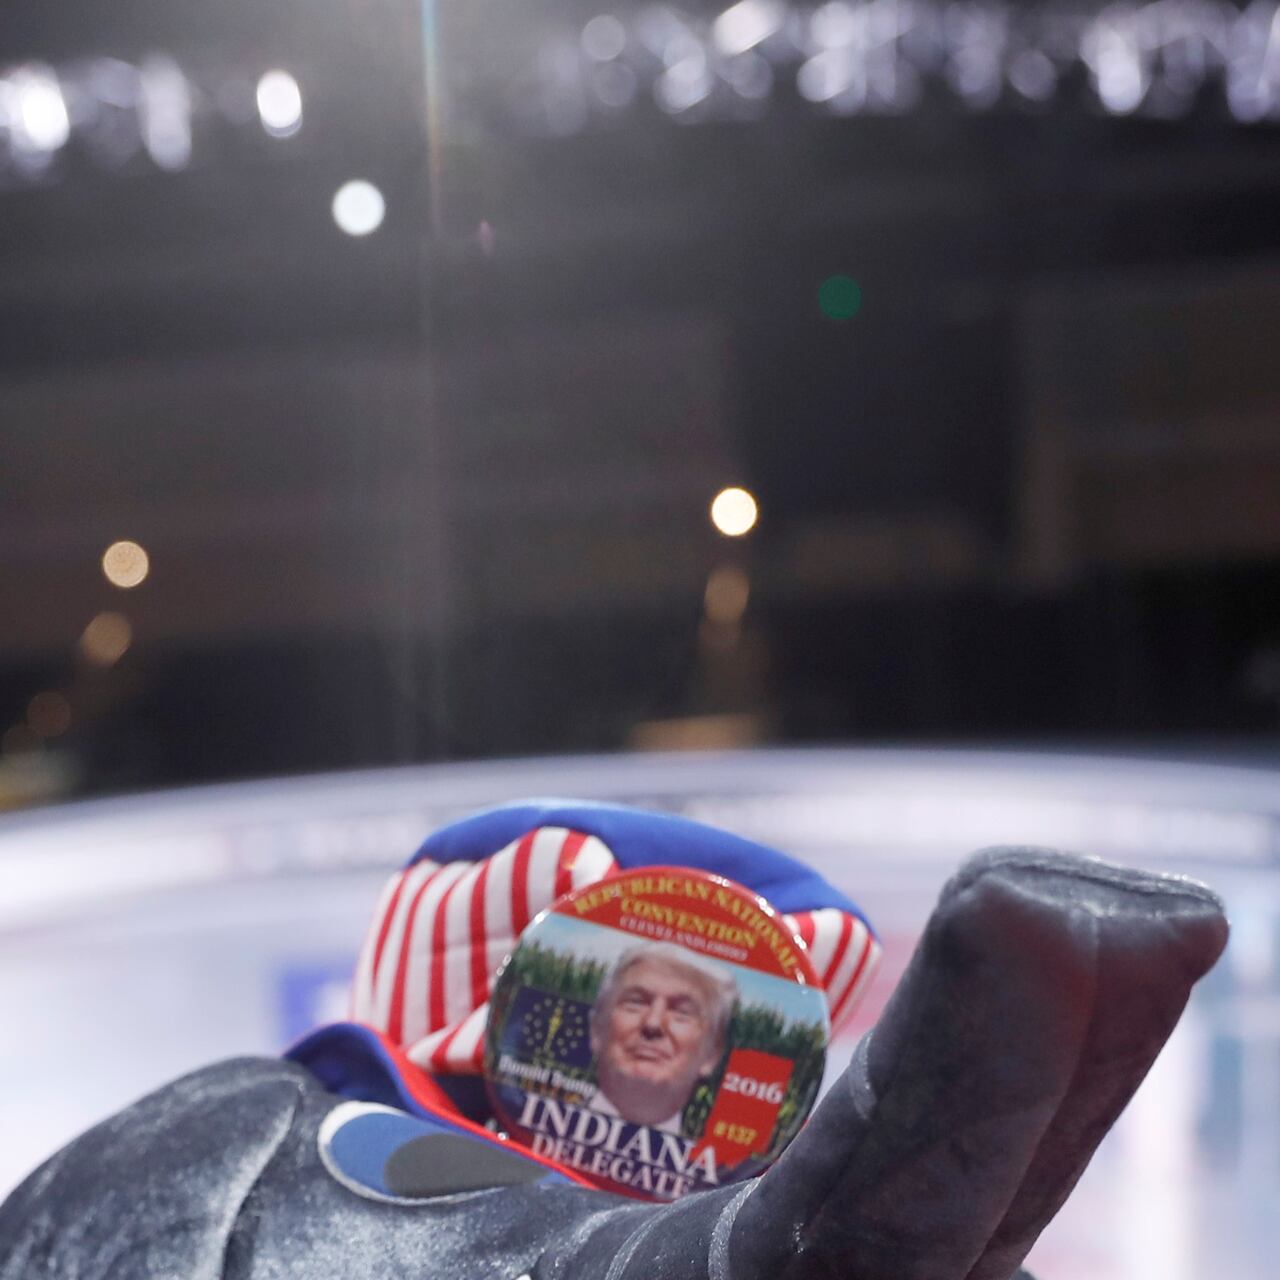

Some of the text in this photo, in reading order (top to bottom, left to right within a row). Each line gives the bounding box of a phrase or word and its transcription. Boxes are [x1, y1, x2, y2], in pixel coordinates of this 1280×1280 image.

[575, 876, 799, 972] REPUBLICAN NATIONAL
[621, 899, 756, 948] CONVENTION
[722, 1072, 783, 1104] 2016
[518, 1093, 718, 1184] INDIANA
[531, 1131, 694, 1200] DELEGATE
